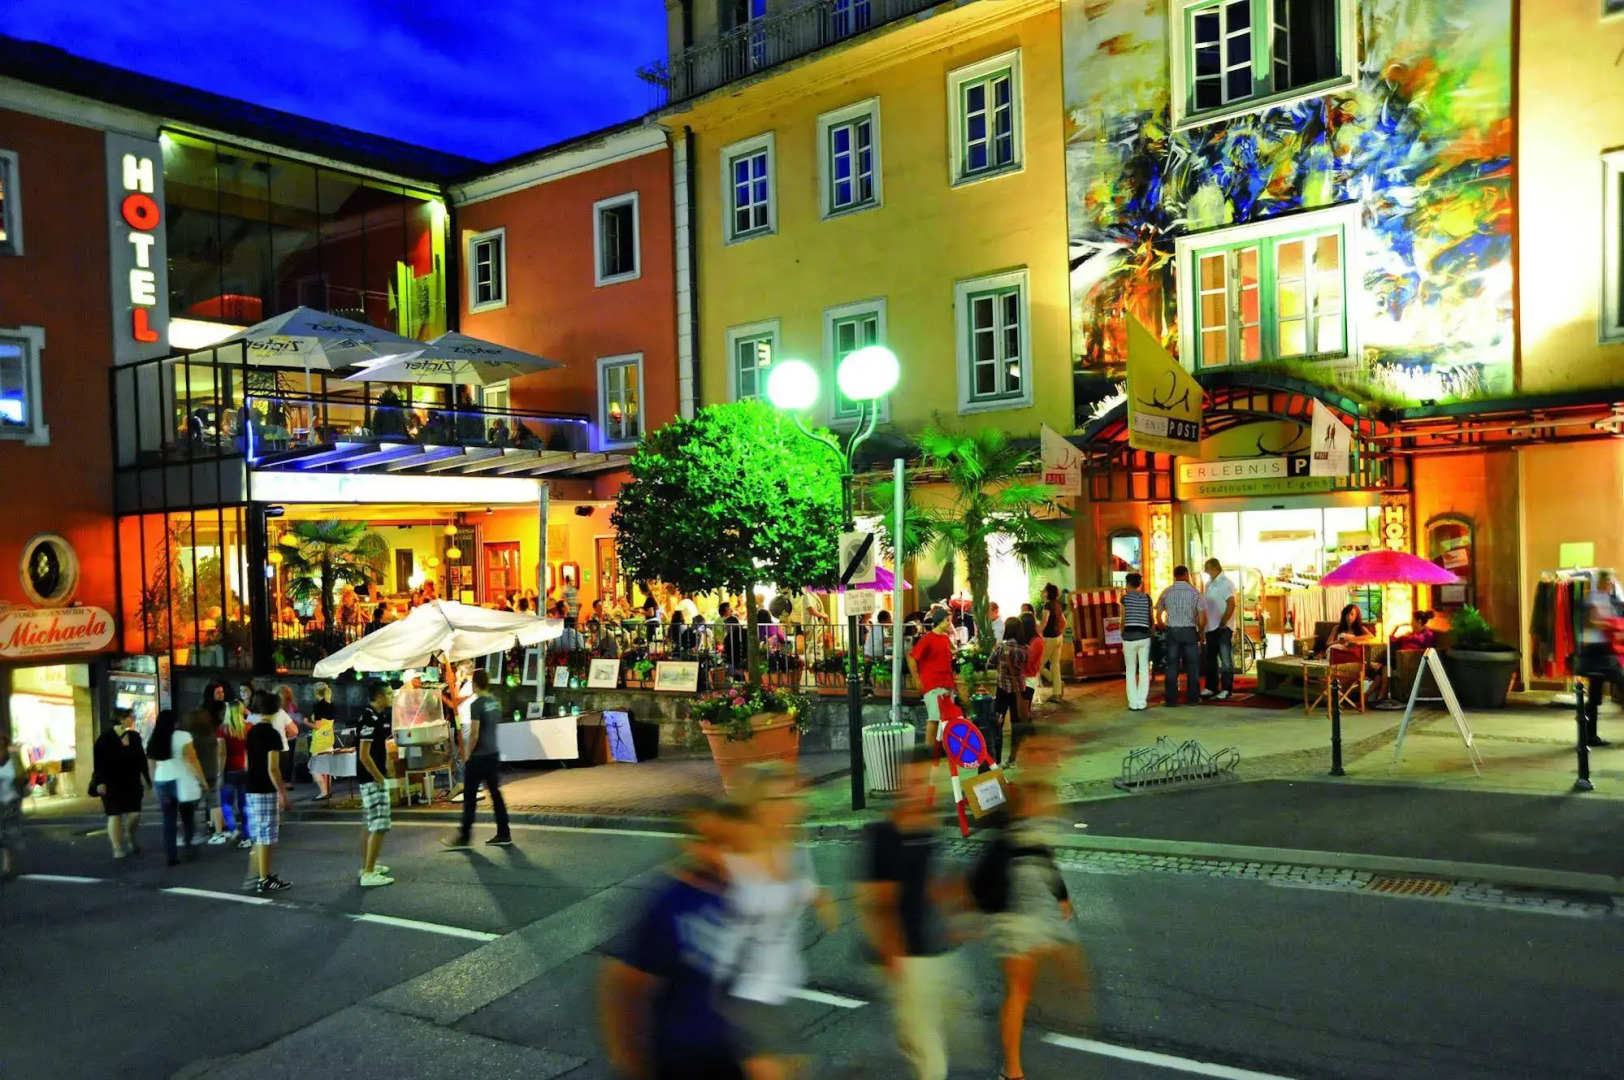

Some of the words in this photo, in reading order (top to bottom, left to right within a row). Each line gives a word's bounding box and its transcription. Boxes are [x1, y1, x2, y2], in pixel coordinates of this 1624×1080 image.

[121, 154, 160, 342] HOTEL
[1168, 421, 1197, 439] POST
[1186, 463, 1281, 478] ERLEBNIS
[1198, 482, 1257, 494] Stadthotel
[1262, 482, 1281, 491] mit
[1385, 506, 1405, 552] HOT
[0, 611, 107, 650] Michaela
[963, 760, 981, 769] ENDE
